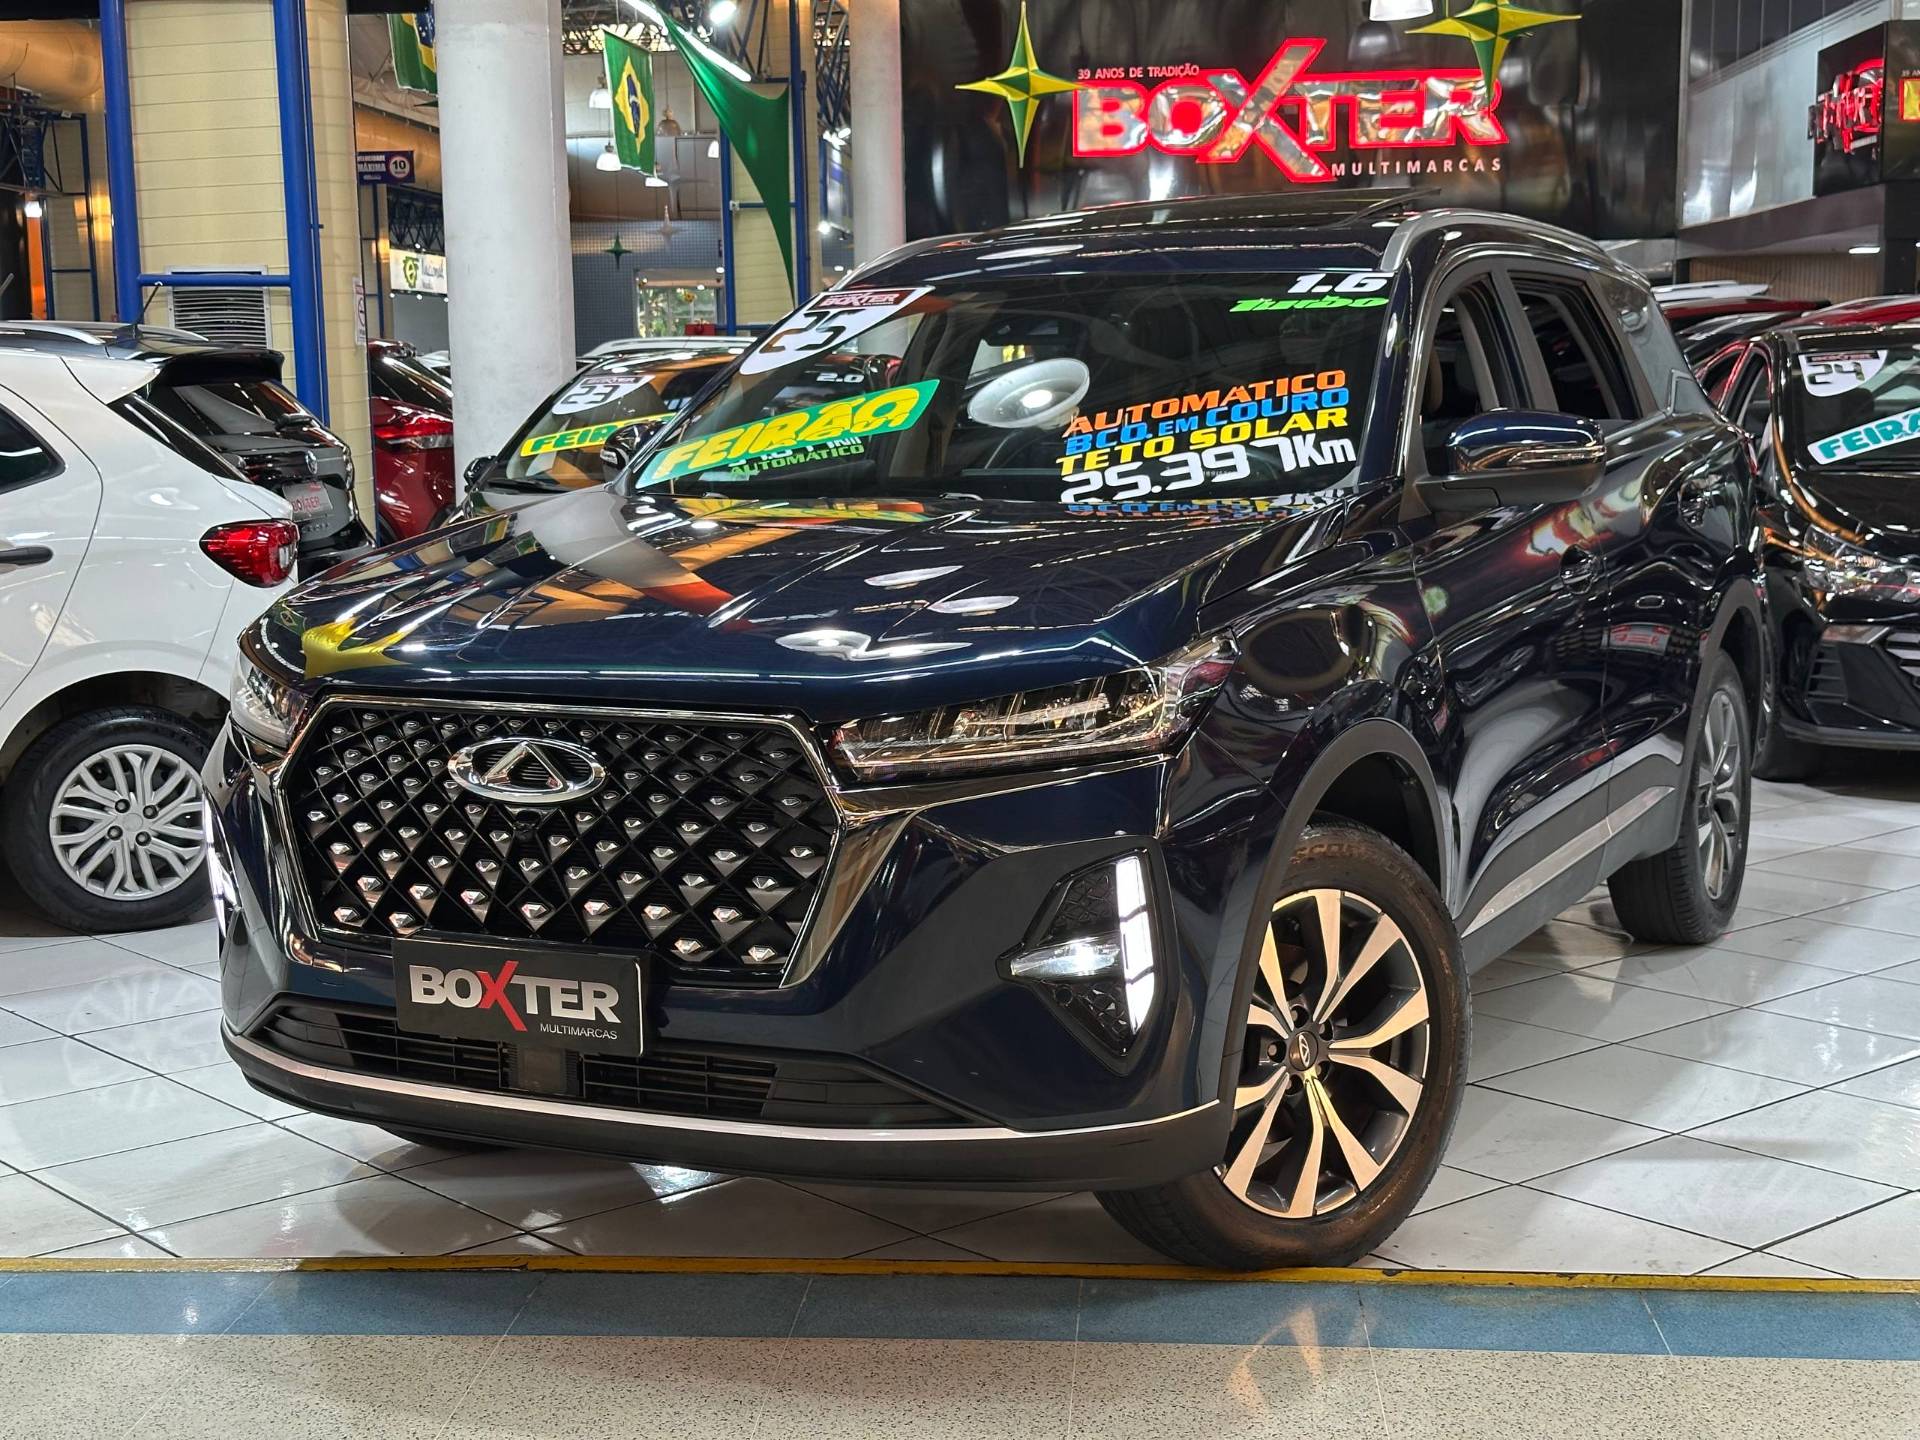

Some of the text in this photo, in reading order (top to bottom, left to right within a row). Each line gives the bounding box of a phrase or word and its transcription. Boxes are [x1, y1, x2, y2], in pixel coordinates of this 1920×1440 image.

[1078, 62, 1200, 80] 39 ANOS DE TRADIÇÃO
[1073, 38, 1510, 183] BOXTER
[392, 160, 407, 170] 10
[1331, 157, 1501, 177] MULTIMARCAS
[1287, 272, 1394, 294] 1.6
[820, 291, 900, 307] BOXTER
[758, 308, 867, 354] 25
[816, 372, 865, 384] 2.0
[1807, 361, 1865, 385] 24
[561, 384, 621, 405] 23
[1205, 387, 1350, 427] COURO
[653, 388, 920, 480] FEIRÃO
[1055, 407, 1349, 476] TETO SOLAR
[408, 959, 622, 1032] BOXTER
[540, 1022, 618, 1040] MULTIMARCAS
